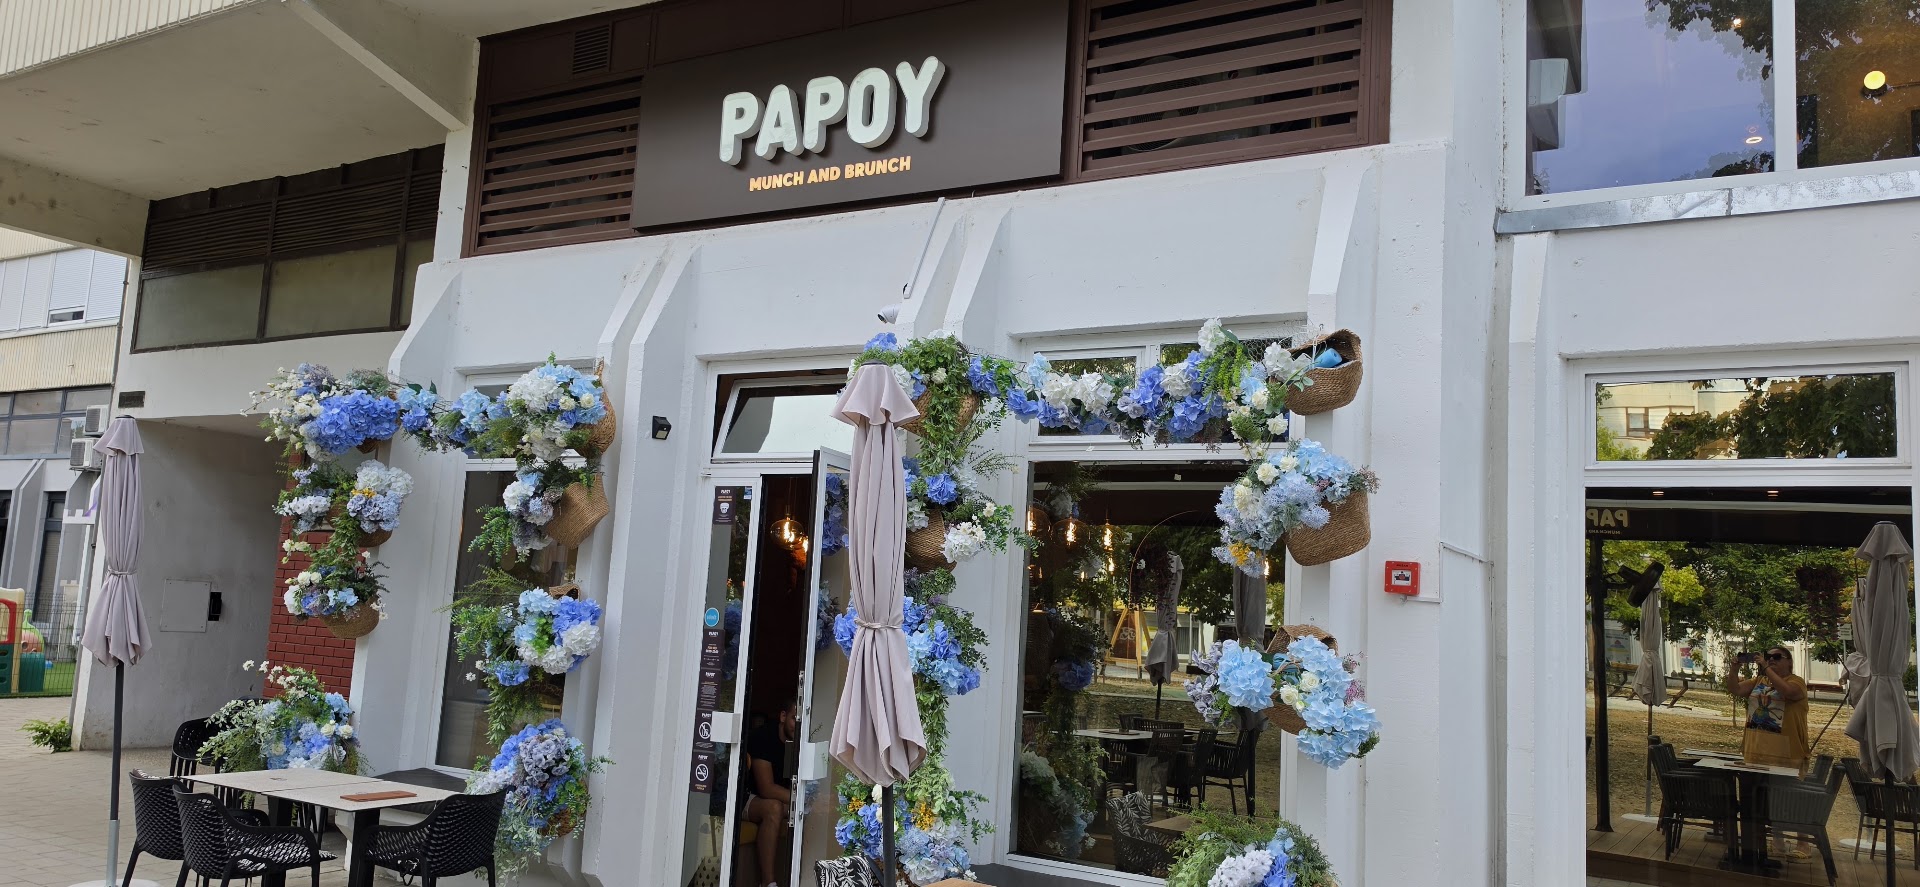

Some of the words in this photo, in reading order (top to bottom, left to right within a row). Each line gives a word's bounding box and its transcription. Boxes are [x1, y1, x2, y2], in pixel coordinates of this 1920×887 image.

[719, 55, 946, 166] PAPOY
[749, 171, 804, 192] MUNCH
[807, 166, 841, 184] AND
[844, 155, 912, 179] BRUNCH
